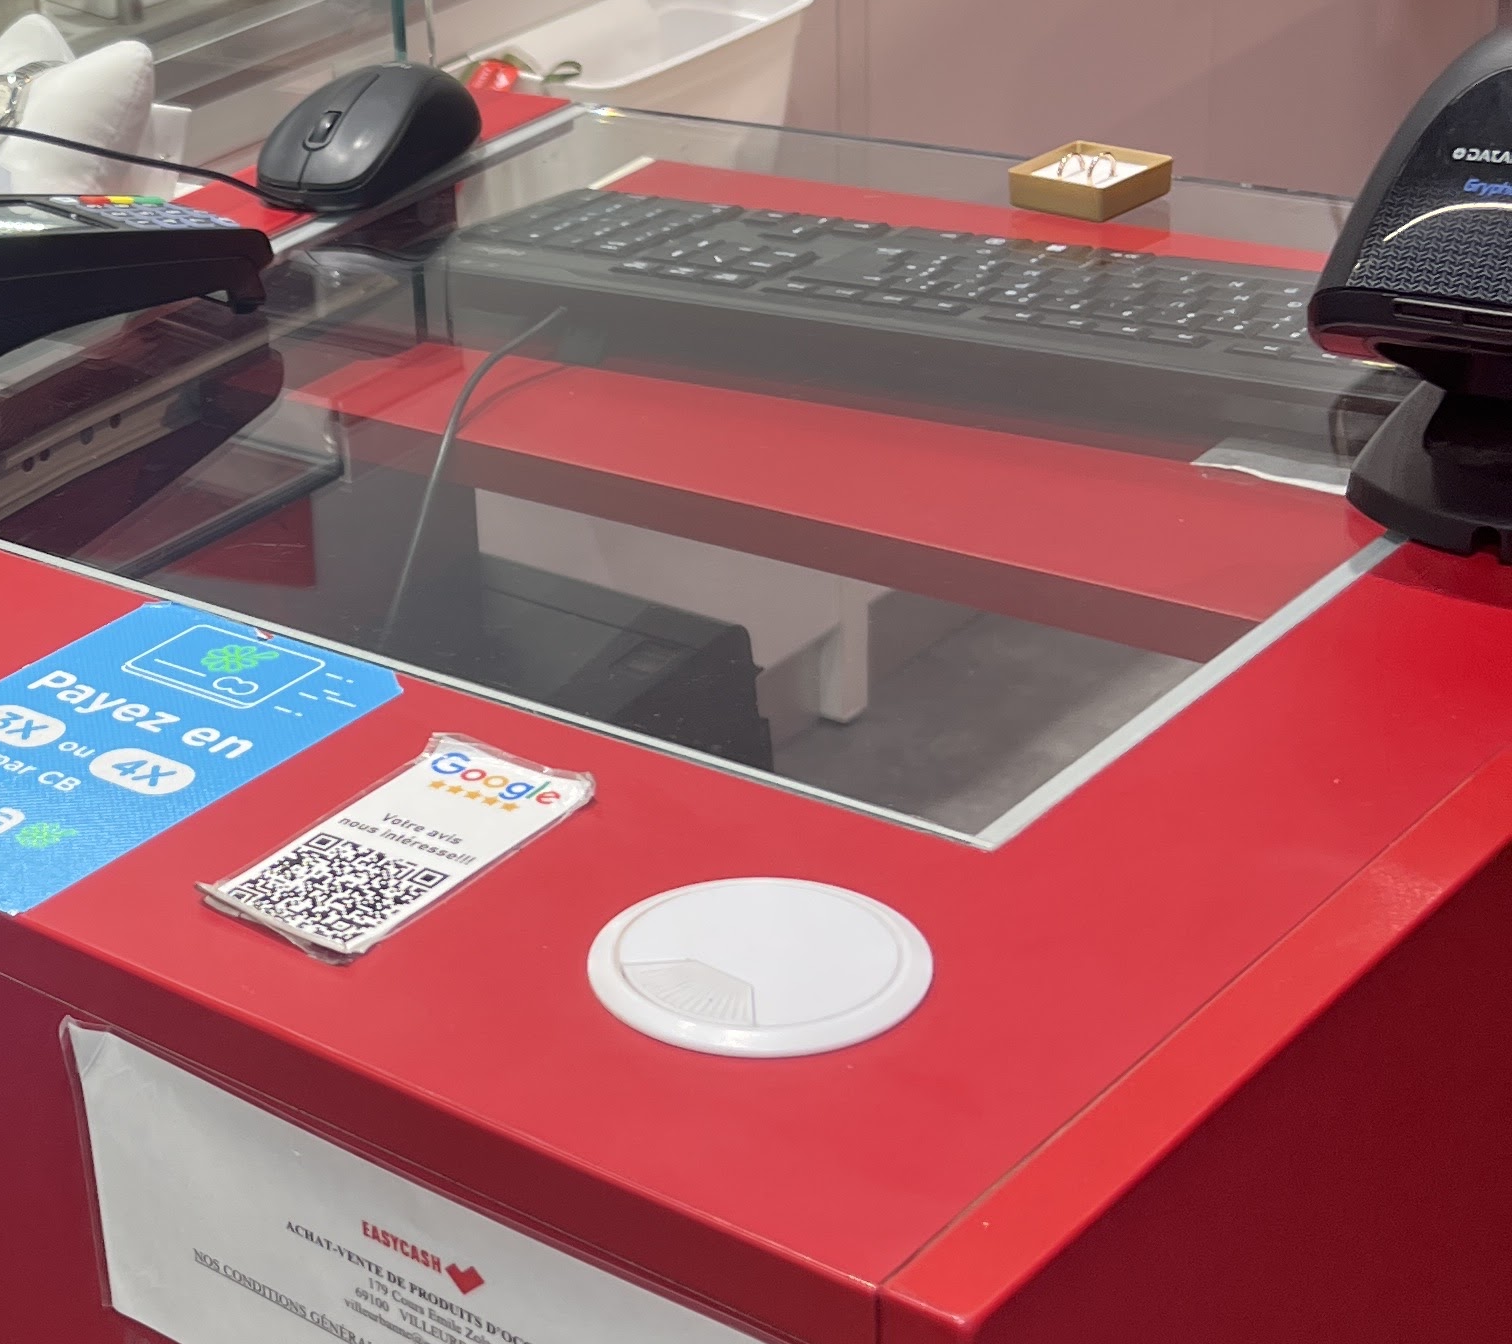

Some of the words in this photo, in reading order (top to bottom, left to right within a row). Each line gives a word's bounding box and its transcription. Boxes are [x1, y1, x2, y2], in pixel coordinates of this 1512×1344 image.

[27, 670, 180, 734] Payez
[181, 726, 254, 760] en
[37, 771, 83, 793] CB
[57, 739, 96, 760] ou
[111, 758, 179, 788] 4X
[430, 752, 561, 804] Google
[338, 814, 379, 836] nous
[381, 813, 425, 835] Votre
[427, 826, 463, 846] avis
[361, 1219, 443, 1274] EASYCASH
[193, 1247, 221, 1273] NOS
[222, 1264, 308, 1320] CONDITIONS
[285, 1220, 385, 1279] ACHAT-VENTE
[386, 1270, 407, 1290] DE
[408, 1281, 484, 1329] PRODUITS
[354, 1286, 390, 1313] 69100
[368, 1276, 389, 1296] 179
[391, 1289, 425, 1316] Cours
[427, 1308, 463, 1335] Emile
